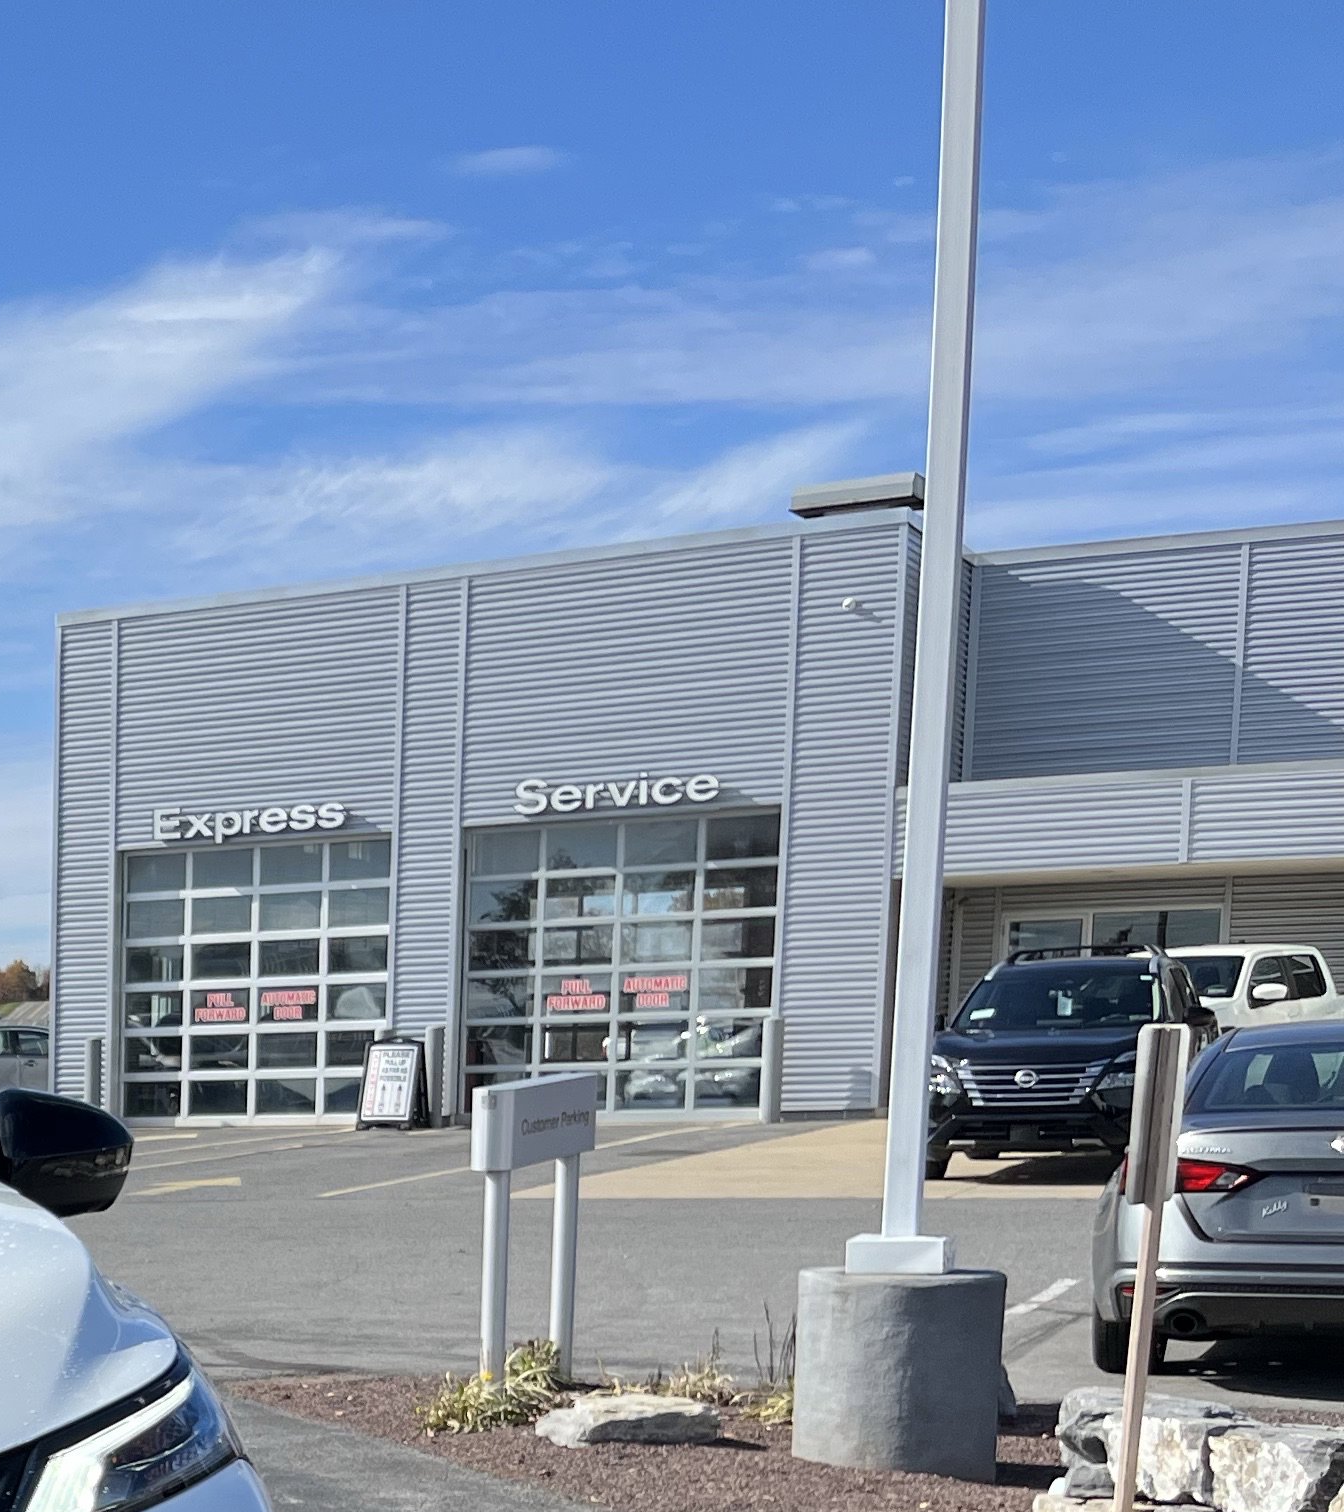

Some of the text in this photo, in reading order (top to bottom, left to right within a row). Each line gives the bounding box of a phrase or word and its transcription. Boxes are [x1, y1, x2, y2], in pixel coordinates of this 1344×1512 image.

[513, 772, 720, 815] Service
[153, 802, 346, 844] Express
[623, 975, 688, 993] AUTOMATIC
[261, 990, 316, 1006] AUTOMATIC
[547, 994, 606, 1010] FORWARD
[636, 992, 669, 1008] DOOR
[195, 1006, 246, 1022] FORWARD
[273, 1005, 303, 1020] DOOR
[521, 1109, 590, 1136] Customer Parking
